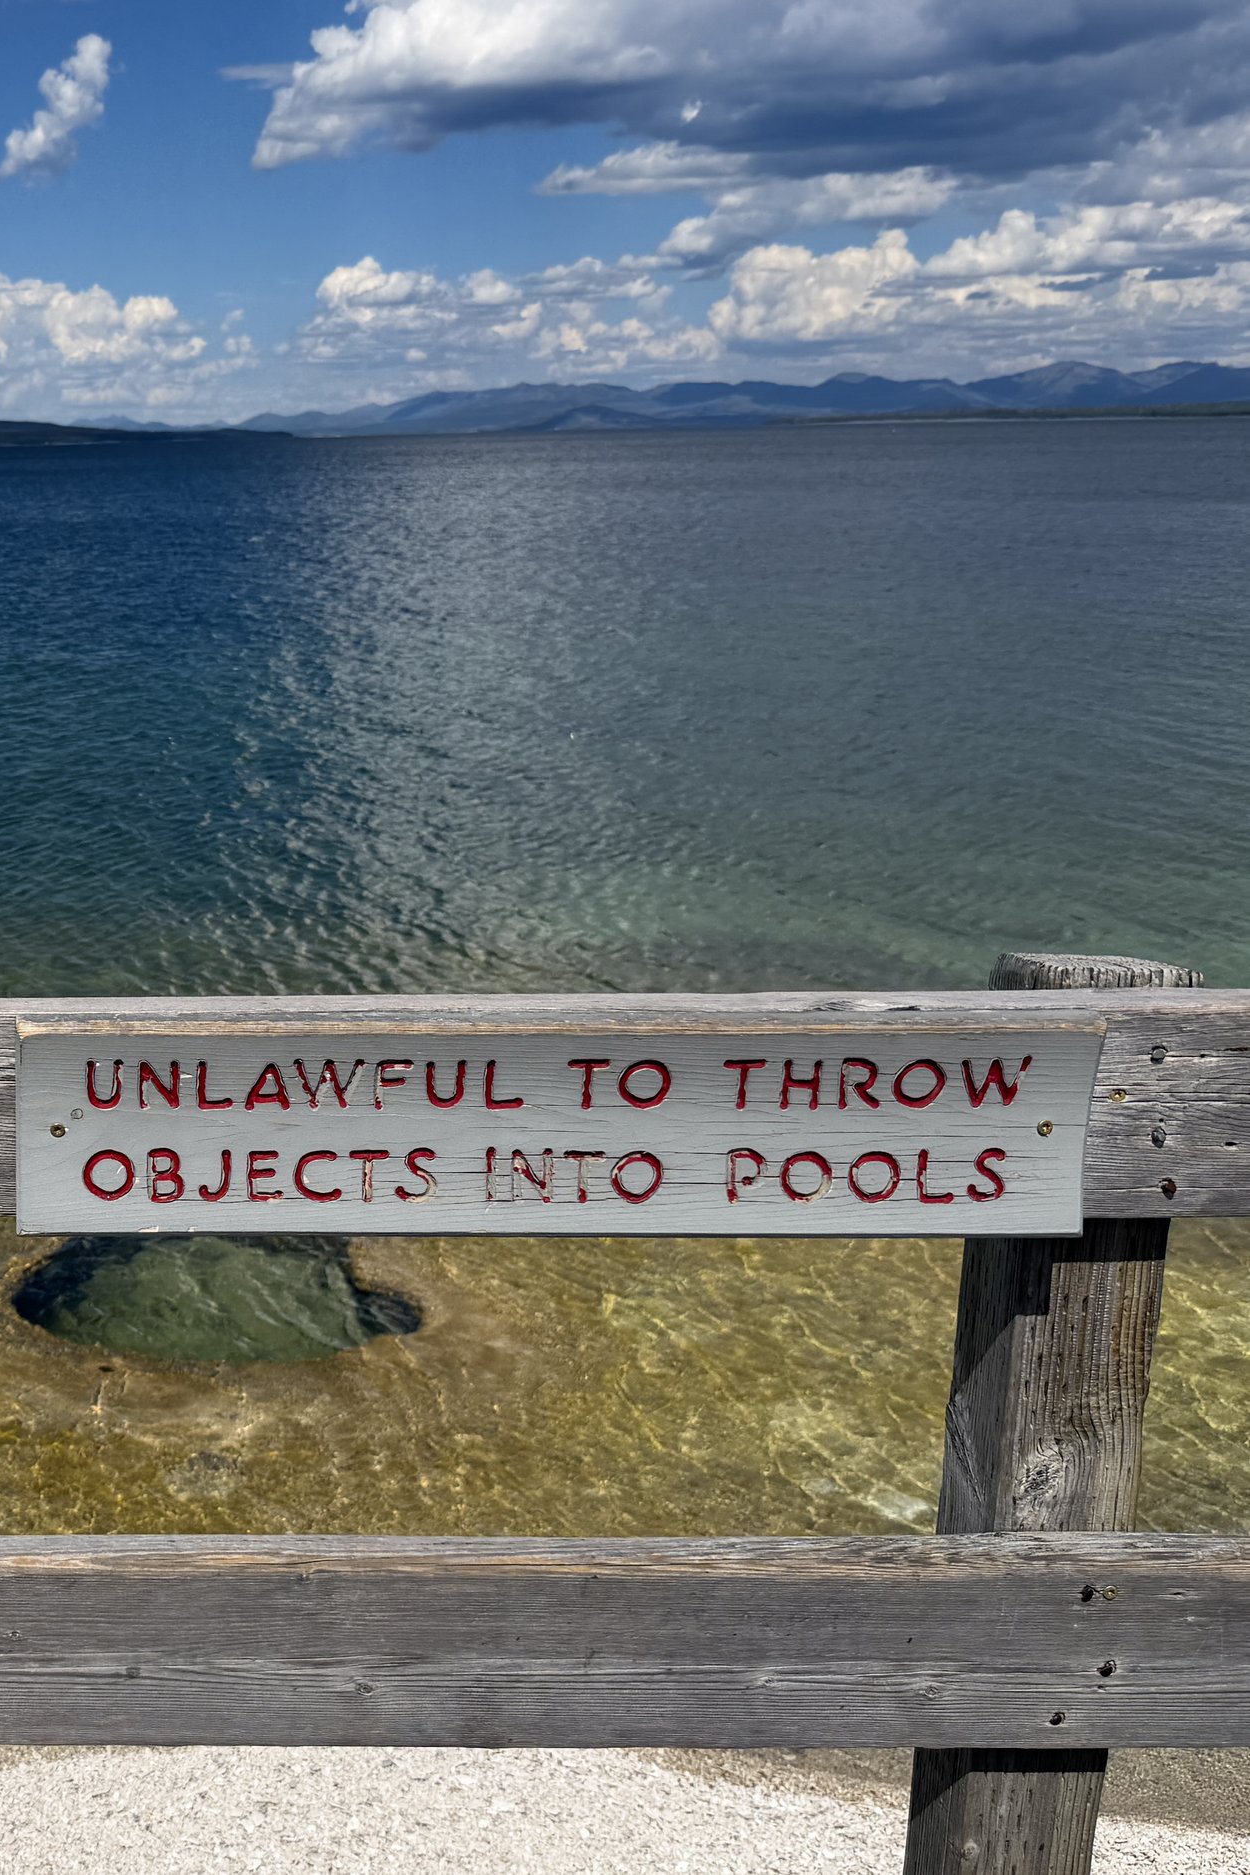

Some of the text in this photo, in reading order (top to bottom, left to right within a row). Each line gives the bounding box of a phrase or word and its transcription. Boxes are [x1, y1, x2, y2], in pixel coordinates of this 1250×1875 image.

[85, 1054, 1034, 1111] UNLAWFUL TO THROW
[81, 1146, 1007, 1205] OBJECTS INTO POOLS
